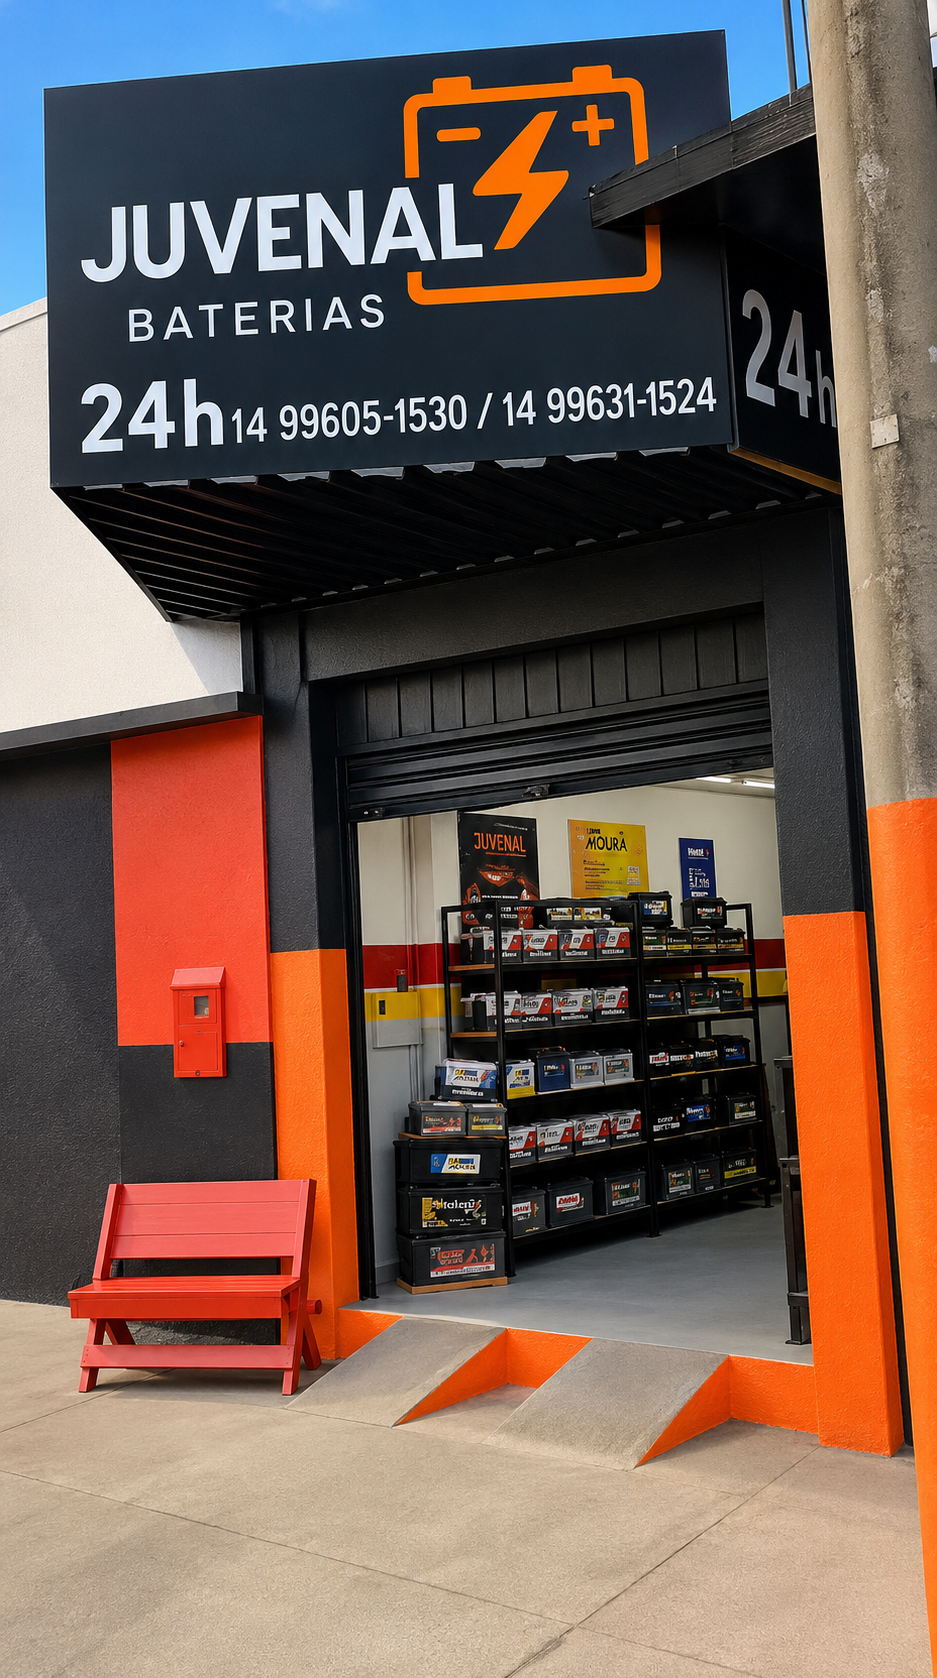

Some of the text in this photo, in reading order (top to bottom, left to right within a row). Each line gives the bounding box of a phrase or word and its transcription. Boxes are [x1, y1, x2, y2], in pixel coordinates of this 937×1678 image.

[81, 184, 484, 283] JUVENAL
[128, 293, 385, 343] BATERIAS
[742, 289, 837, 428] 24h
[81, 376, 717, 454] 24h 14 99605-1530 / 14 99631-1524
[473, 831, 526, 853] JUVENAL
[585, 836, 628, 852] MOURA
